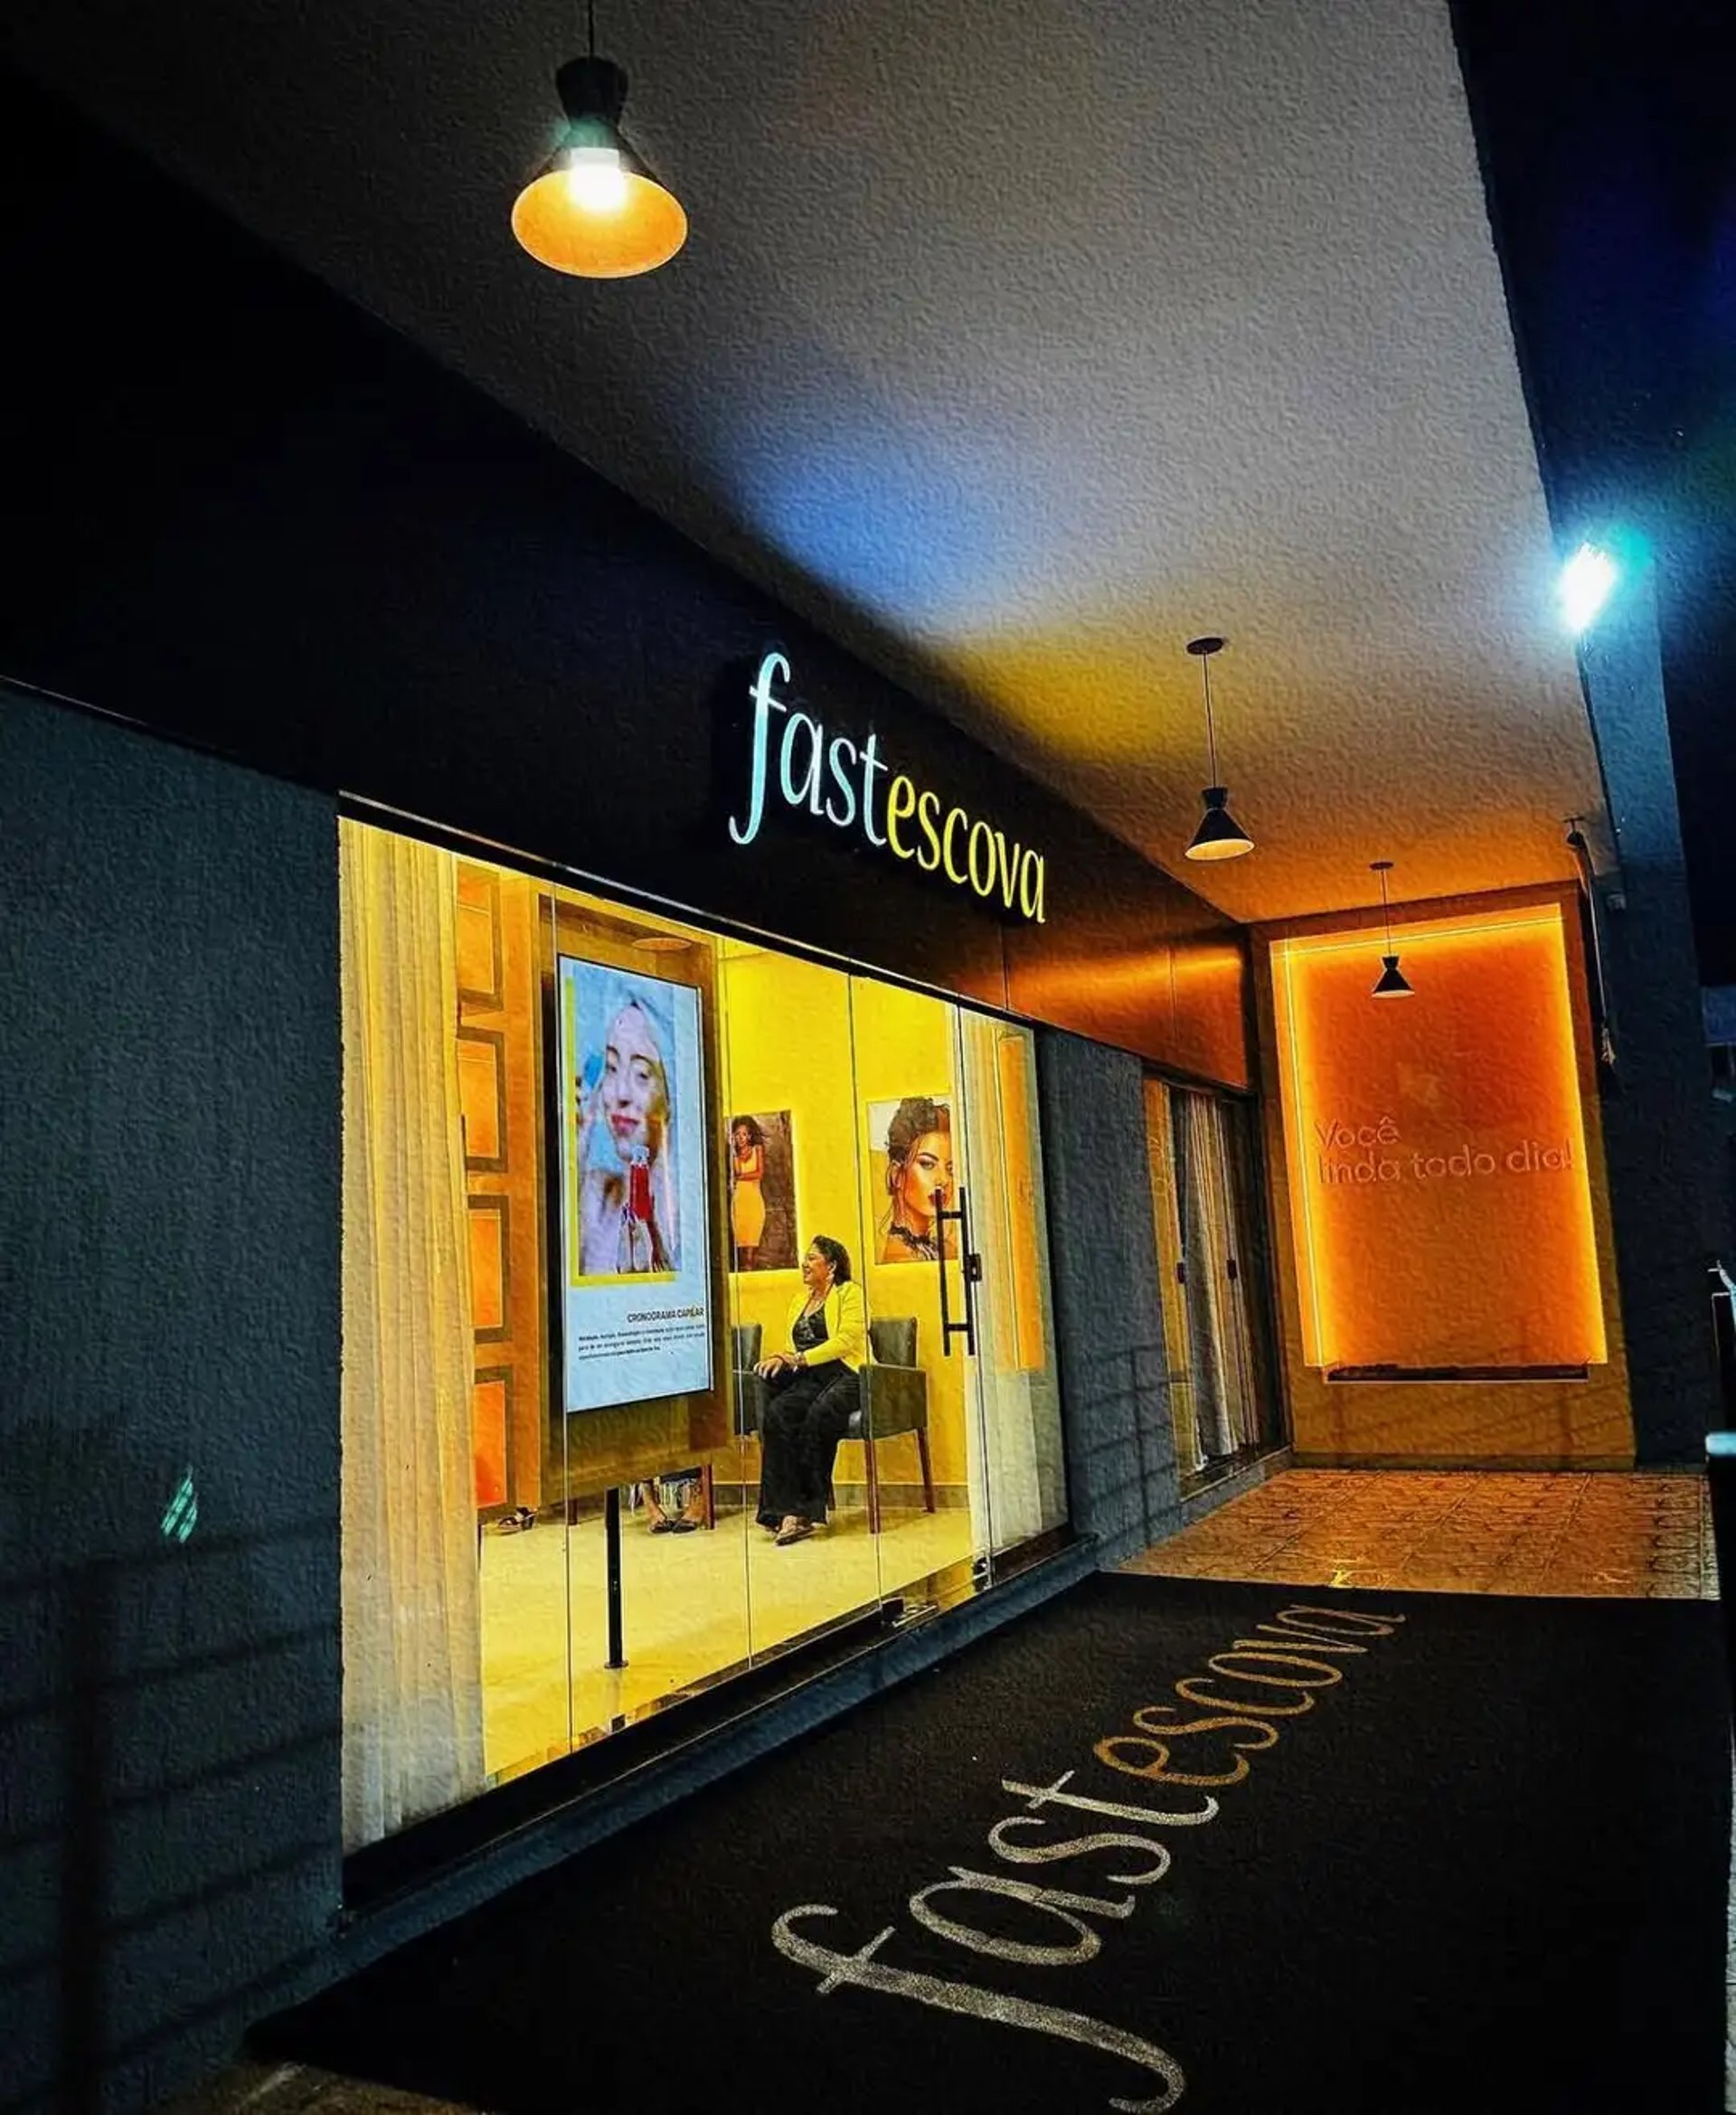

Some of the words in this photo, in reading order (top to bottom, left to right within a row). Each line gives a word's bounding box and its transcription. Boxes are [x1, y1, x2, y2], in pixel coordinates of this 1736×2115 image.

[728, 652, 1045, 923] fastescova
[1315, 1116, 1401, 1149] Você
[1318, 1150, 1401, 1185] linda
[1410, 1144, 1496, 1179] todo
[1505, 1138, 1574, 1173] dia!
[770, 1604, 1406, 2115] fastescova
